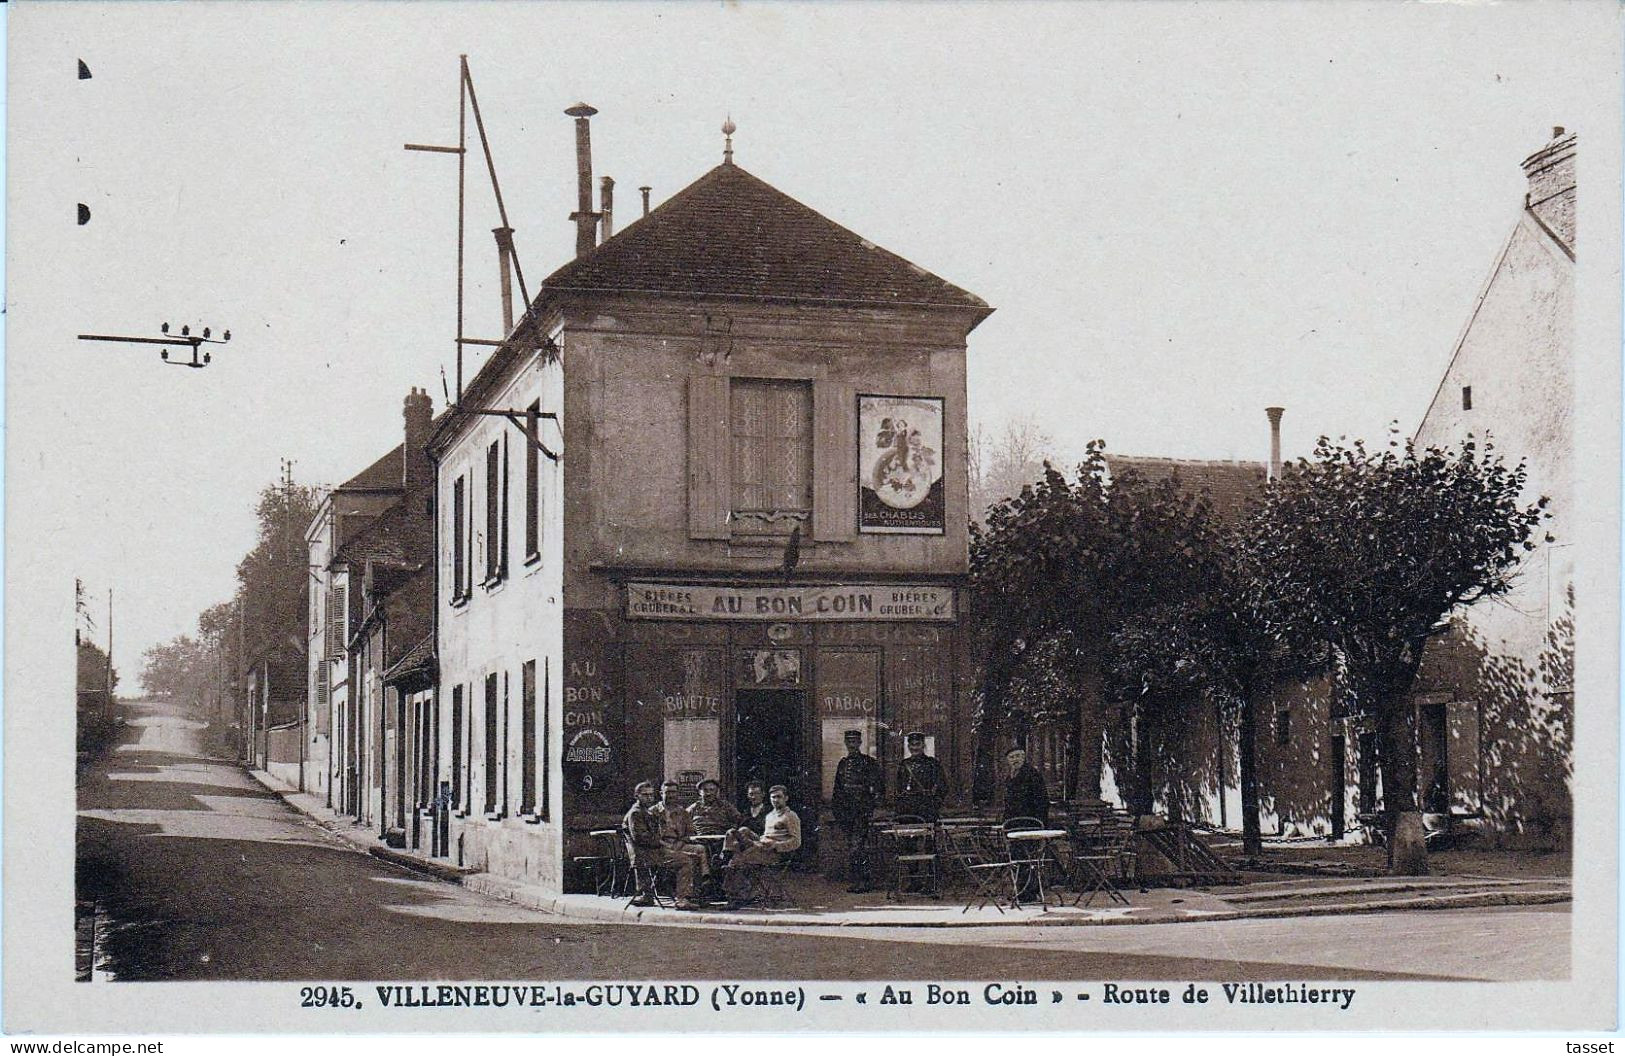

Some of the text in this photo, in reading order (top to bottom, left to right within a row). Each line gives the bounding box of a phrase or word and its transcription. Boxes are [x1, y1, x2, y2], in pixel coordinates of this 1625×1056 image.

[712, 594, 873, 615] AU BON COIN
[571, 660, 597, 676] AU
[565, 686, 602, 703] BON
[665, 694, 720, 713] BUVETTE
[823, 695, 875, 712] TABAC
[564, 710, 603, 726] COIN
[566, 745, 612, 762] ARRÊT
